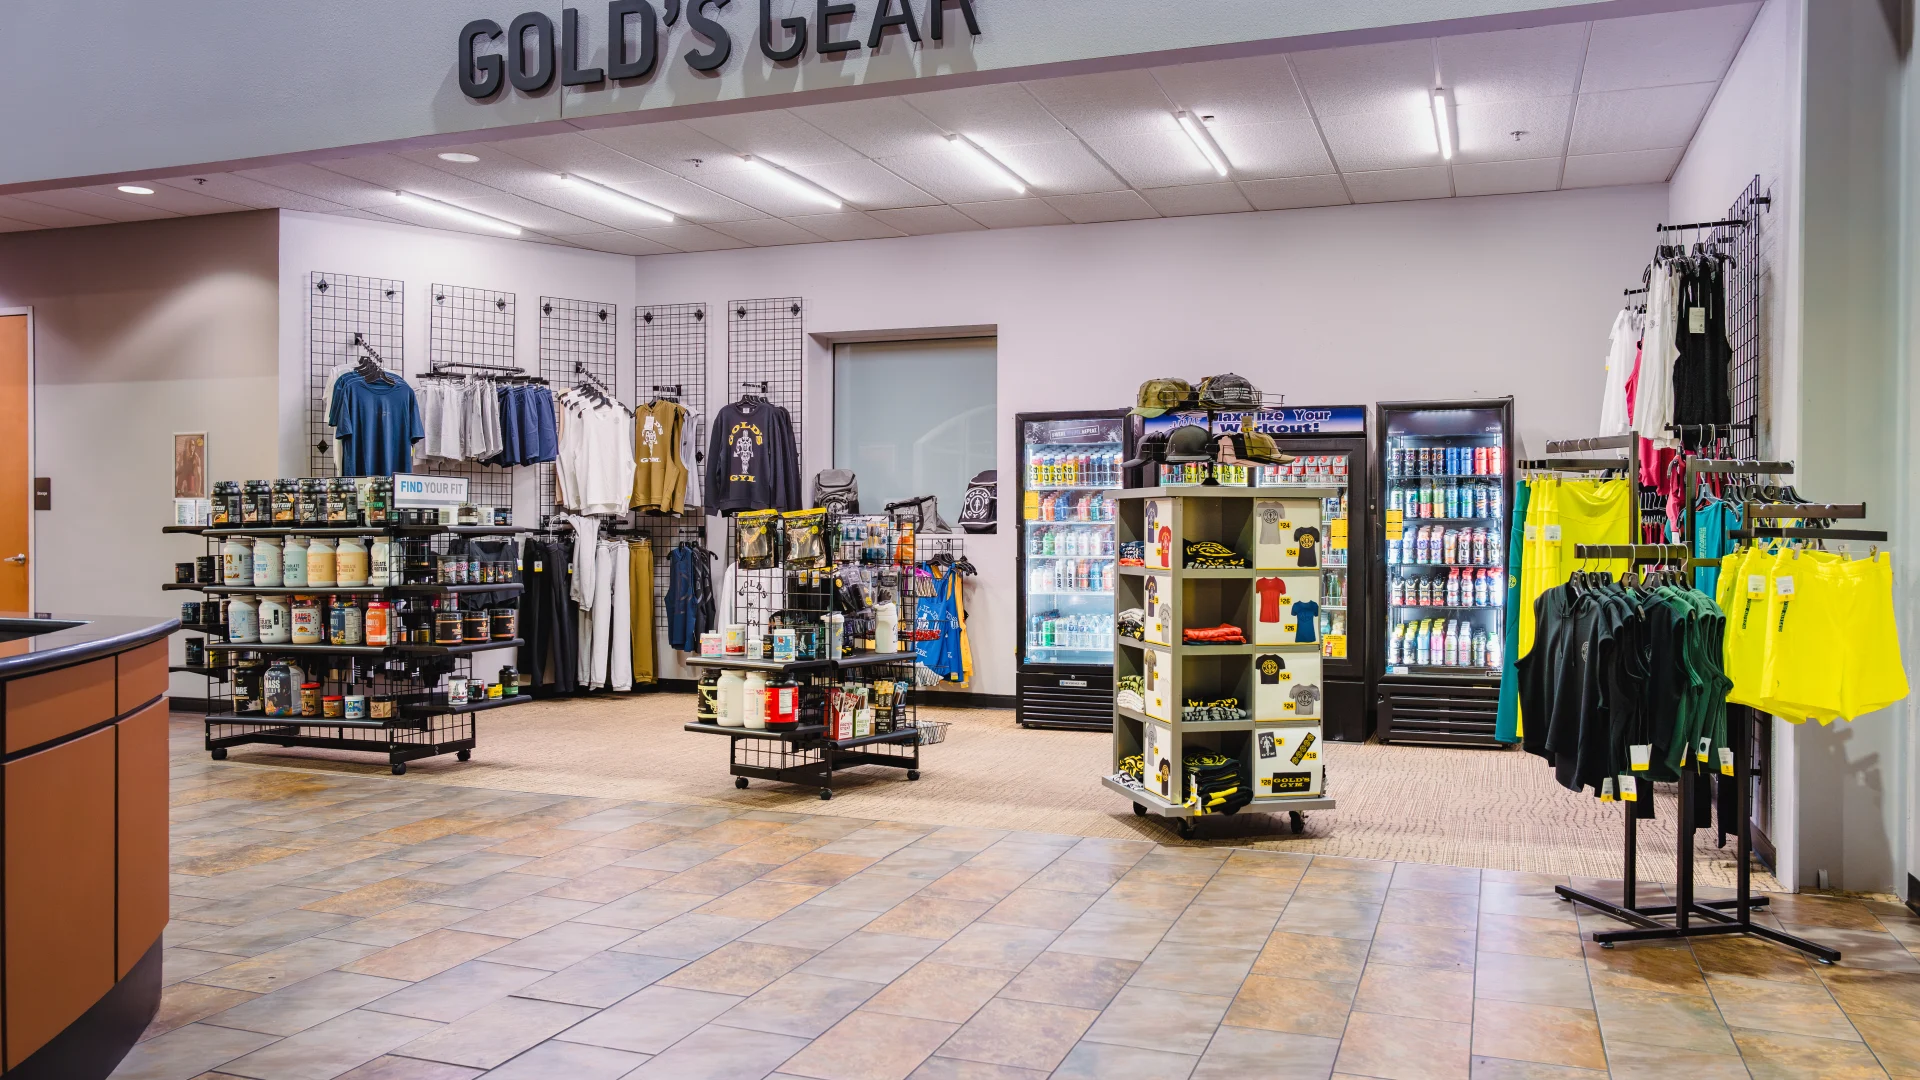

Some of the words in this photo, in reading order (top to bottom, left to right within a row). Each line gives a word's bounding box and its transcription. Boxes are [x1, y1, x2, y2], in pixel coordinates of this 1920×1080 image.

[458, 0, 731, 98] GOLD'S
[1294, 409, 1331, 421] Your
[1219, 423, 1320, 433] Wrkout!
[730, 474, 756, 483] GYM
[400, 480, 423, 493] FIND
[424, 482, 449, 494] YOUR
[450, 483, 463, 494] FIT
